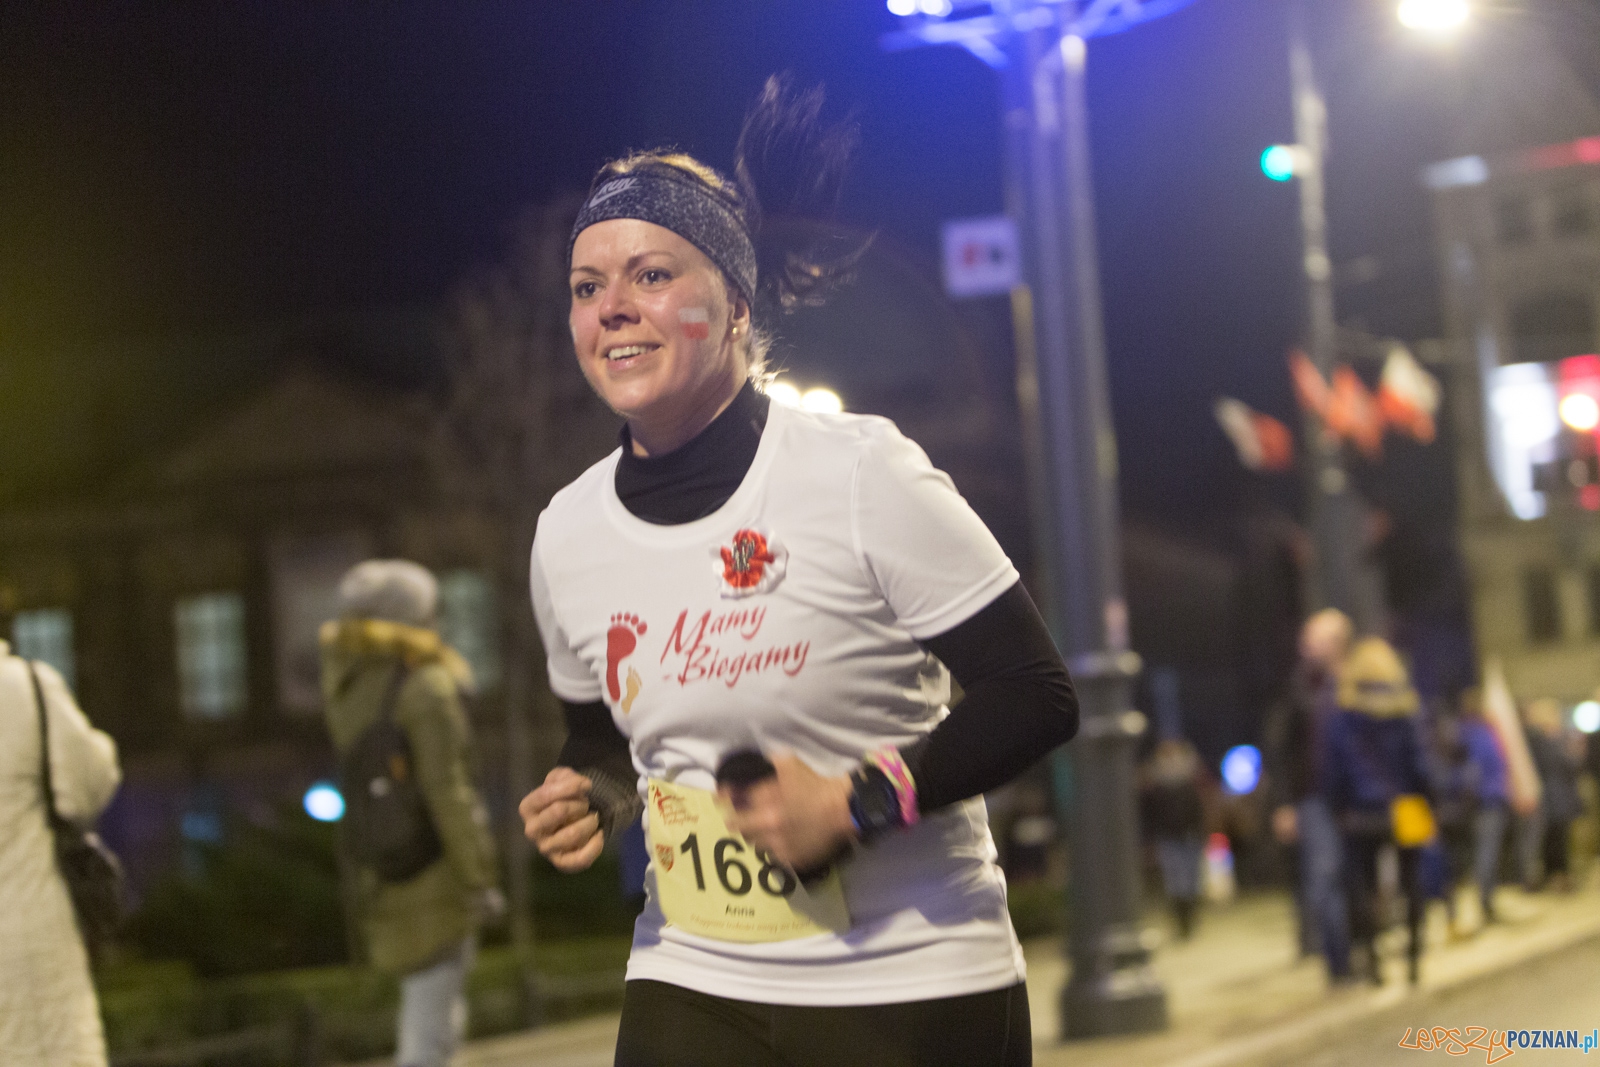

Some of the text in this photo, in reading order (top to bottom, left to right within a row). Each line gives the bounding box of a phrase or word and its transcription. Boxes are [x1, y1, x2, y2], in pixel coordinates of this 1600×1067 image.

[660, 605, 767, 665] Mamy
[680, 832, 797, 897] 168
[725, 904, 755, 917] Anna
